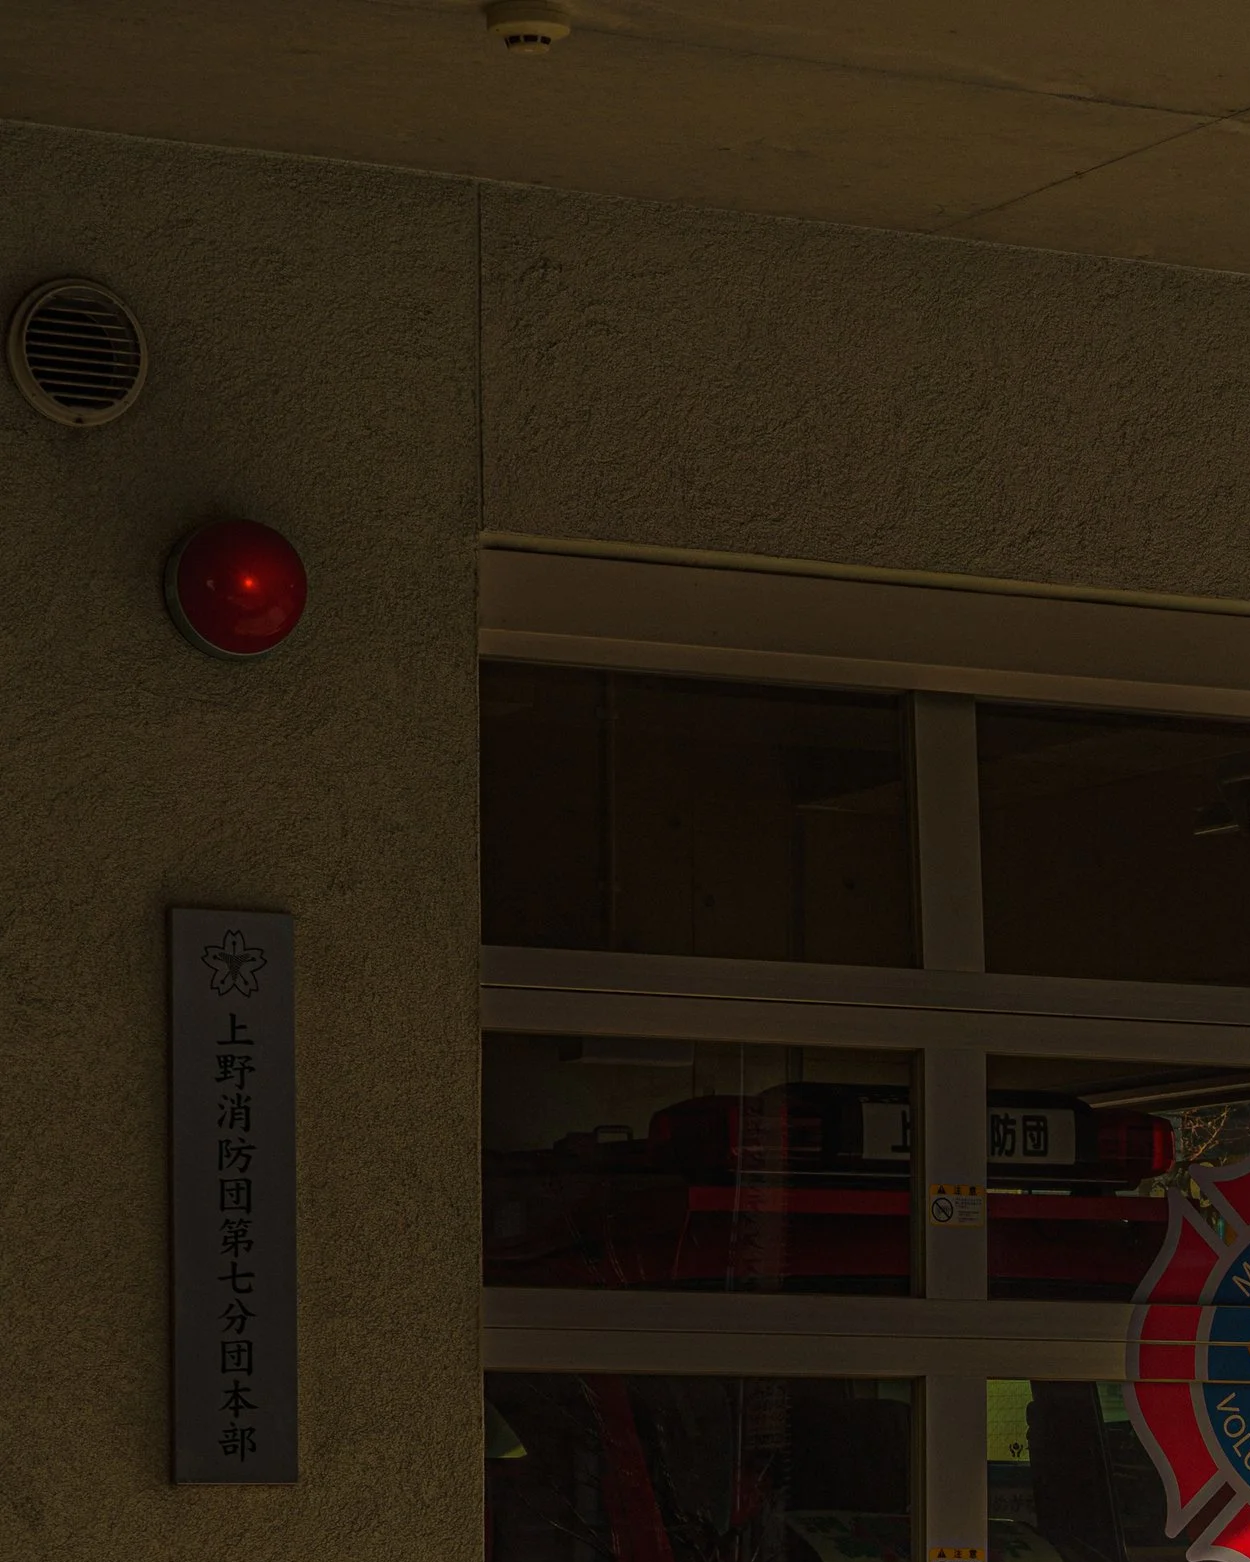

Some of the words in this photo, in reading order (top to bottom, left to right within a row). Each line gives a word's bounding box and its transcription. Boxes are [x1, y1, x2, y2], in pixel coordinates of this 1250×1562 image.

[215, 1012, 258, 1463] 上野消防団第七分団本部
